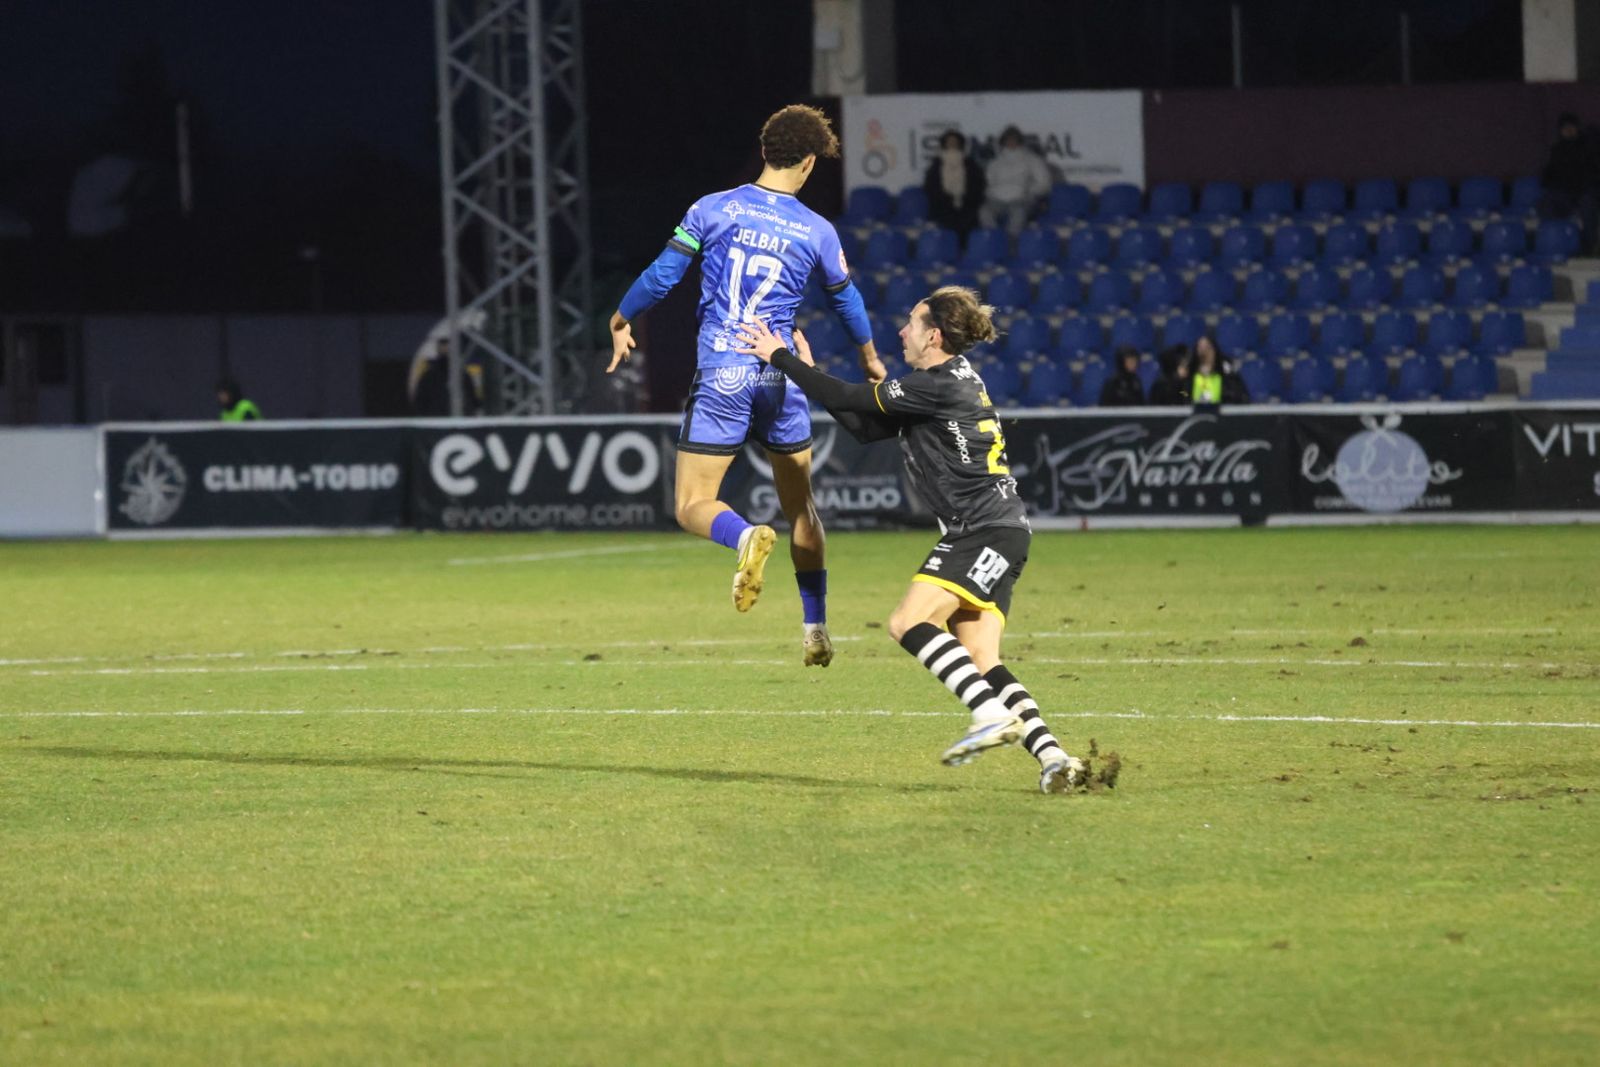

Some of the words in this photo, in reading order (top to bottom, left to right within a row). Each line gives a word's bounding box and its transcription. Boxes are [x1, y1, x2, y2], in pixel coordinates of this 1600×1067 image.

[789, 221, 811, 234] salud
[732, 228, 791, 254] JELBAT
[728, 247, 783, 324] 12
[1074, 440, 1271, 509] Navilla
[442, 503, 656, 529] evvohome.com
